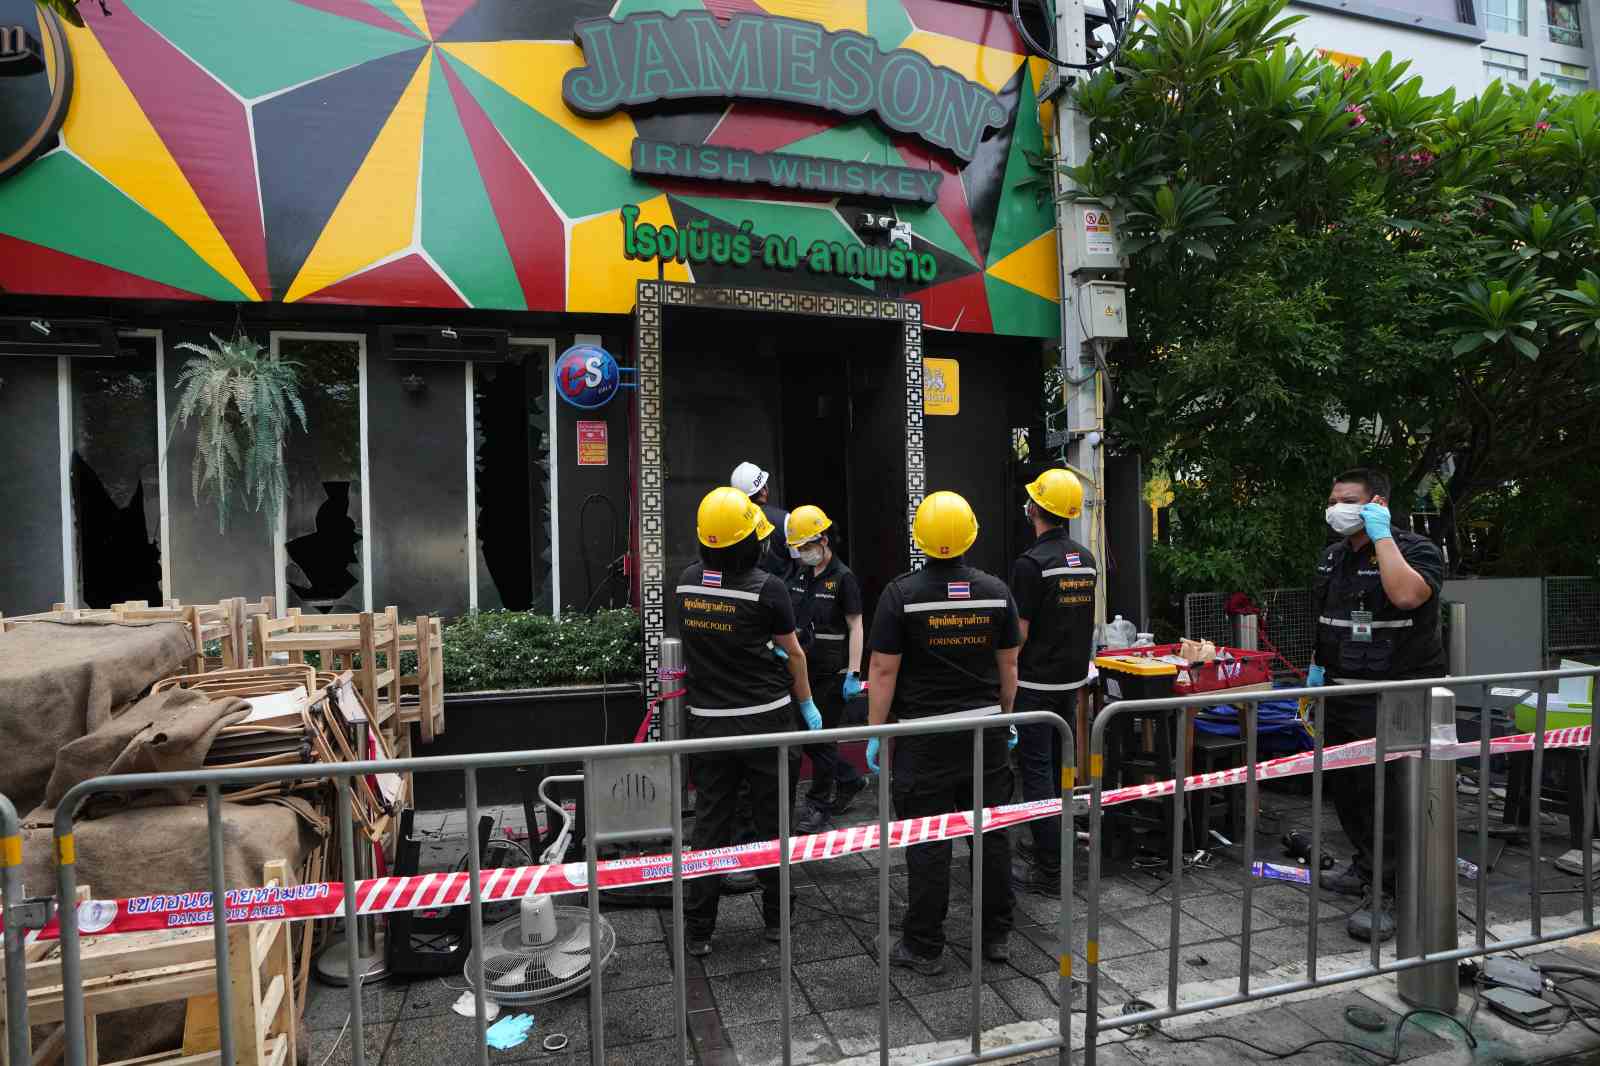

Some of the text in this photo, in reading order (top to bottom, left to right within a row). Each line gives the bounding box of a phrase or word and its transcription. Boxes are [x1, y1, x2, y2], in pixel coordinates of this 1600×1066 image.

[573, 17, 991, 155] JAMESON
[640, 144, 940, 196] IRISH WHISKEY
[642, 861, 709, 878] DANGROUS
[168, 903, 285, 927] DANGEOUS AREA
